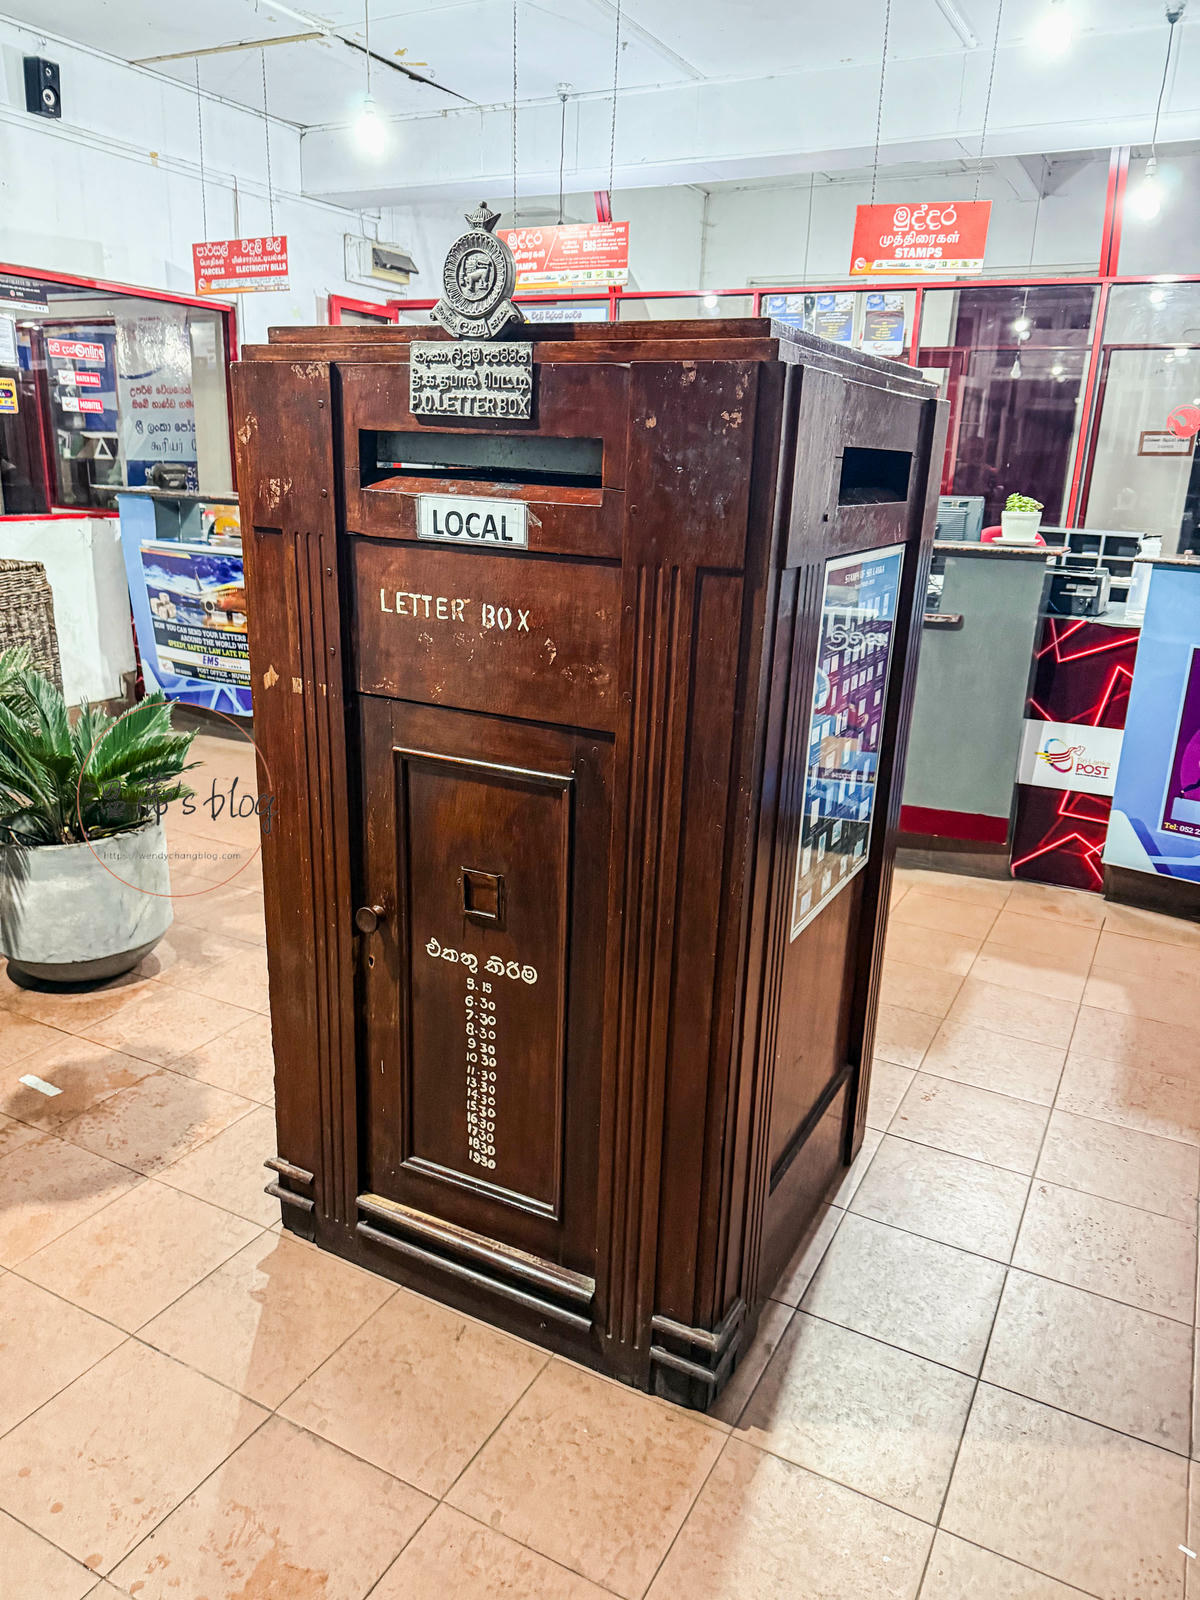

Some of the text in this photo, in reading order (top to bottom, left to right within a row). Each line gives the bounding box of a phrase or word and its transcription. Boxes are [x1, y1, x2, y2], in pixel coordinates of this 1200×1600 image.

[893, 204, 957, 231] මුද්දර
[880, 231, 960, 247] முத்திரைகள்
[894, 247, 943, 258] STAMPS
[201, 267, 225, 276] PARCELS
[236, 264, 269, 273] ELECTRICITY
[499, 396, 530, 415] BOX
[432, 510, 513, 541] LOCAL
[380, 588, 530, 632] LETTER BOX
[166, 623, 177, 632] YOU
[177, 626, 188, 635] CAN
[188, 628, 203, 637] SEND
[202, 631, 219, 640] YOUR
[218, 633, 246, 642] LETTERS
[180, 635, 202, 645] AROUND
[202, 638, 215, 646] THE
[215, 641, 236, 649] WORLD
[202, 655, 220, 666] EMS
[210, 669, 228, 678] OFFICE
[1075, 763, 1110, 776] POST
[1179, 825, 1194, 833] 052
